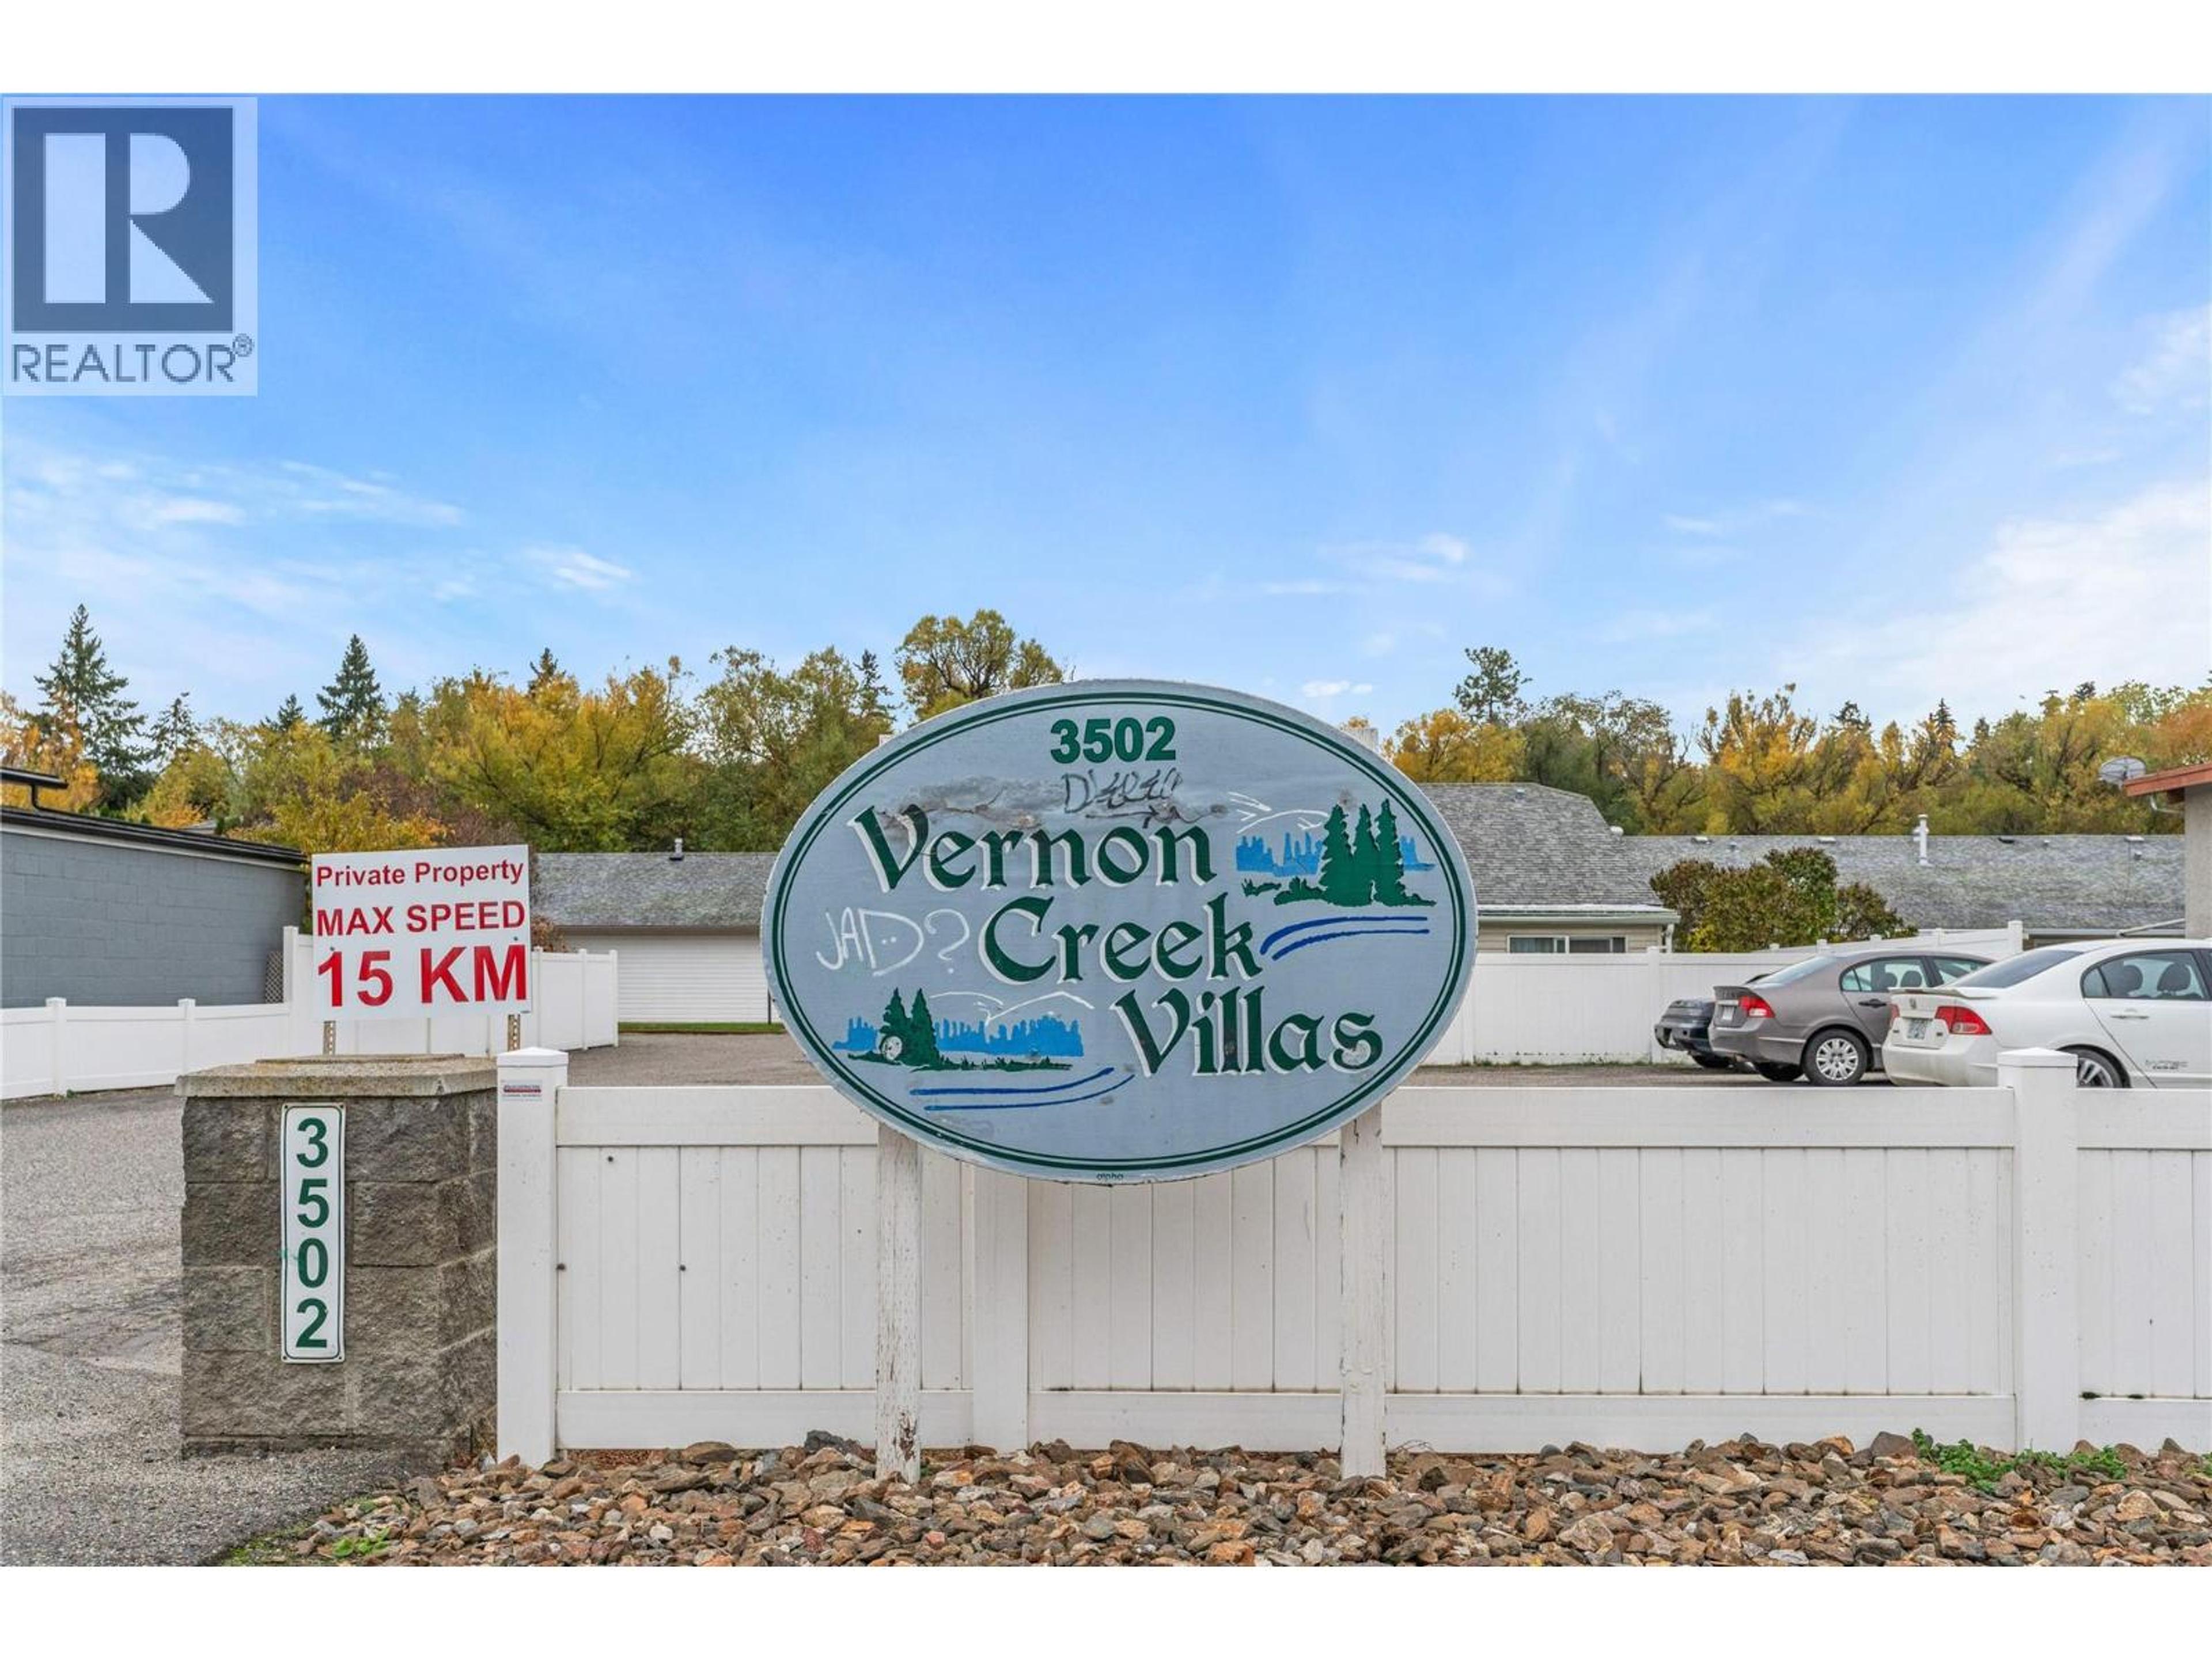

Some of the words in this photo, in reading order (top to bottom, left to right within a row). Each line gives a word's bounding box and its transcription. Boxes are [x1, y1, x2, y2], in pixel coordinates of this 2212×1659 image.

[1051, 717, 1176, 764] 3502
[316, 865, 406, 887] Private
[415, 861, 524, 886] Property
[848, 804, 1218, 893] Vernon
[317, 907, 395, 937] MAX
[407, 900, 525, 933] SPEED
[980, 892, 1264, 984] Creek
[317, 950, 393, 1007] 15
[420, 944, 527, 1003] KM
[1109, 985, 1384, 1077] Villas
[296, 1117, 330, 1349] 3502
